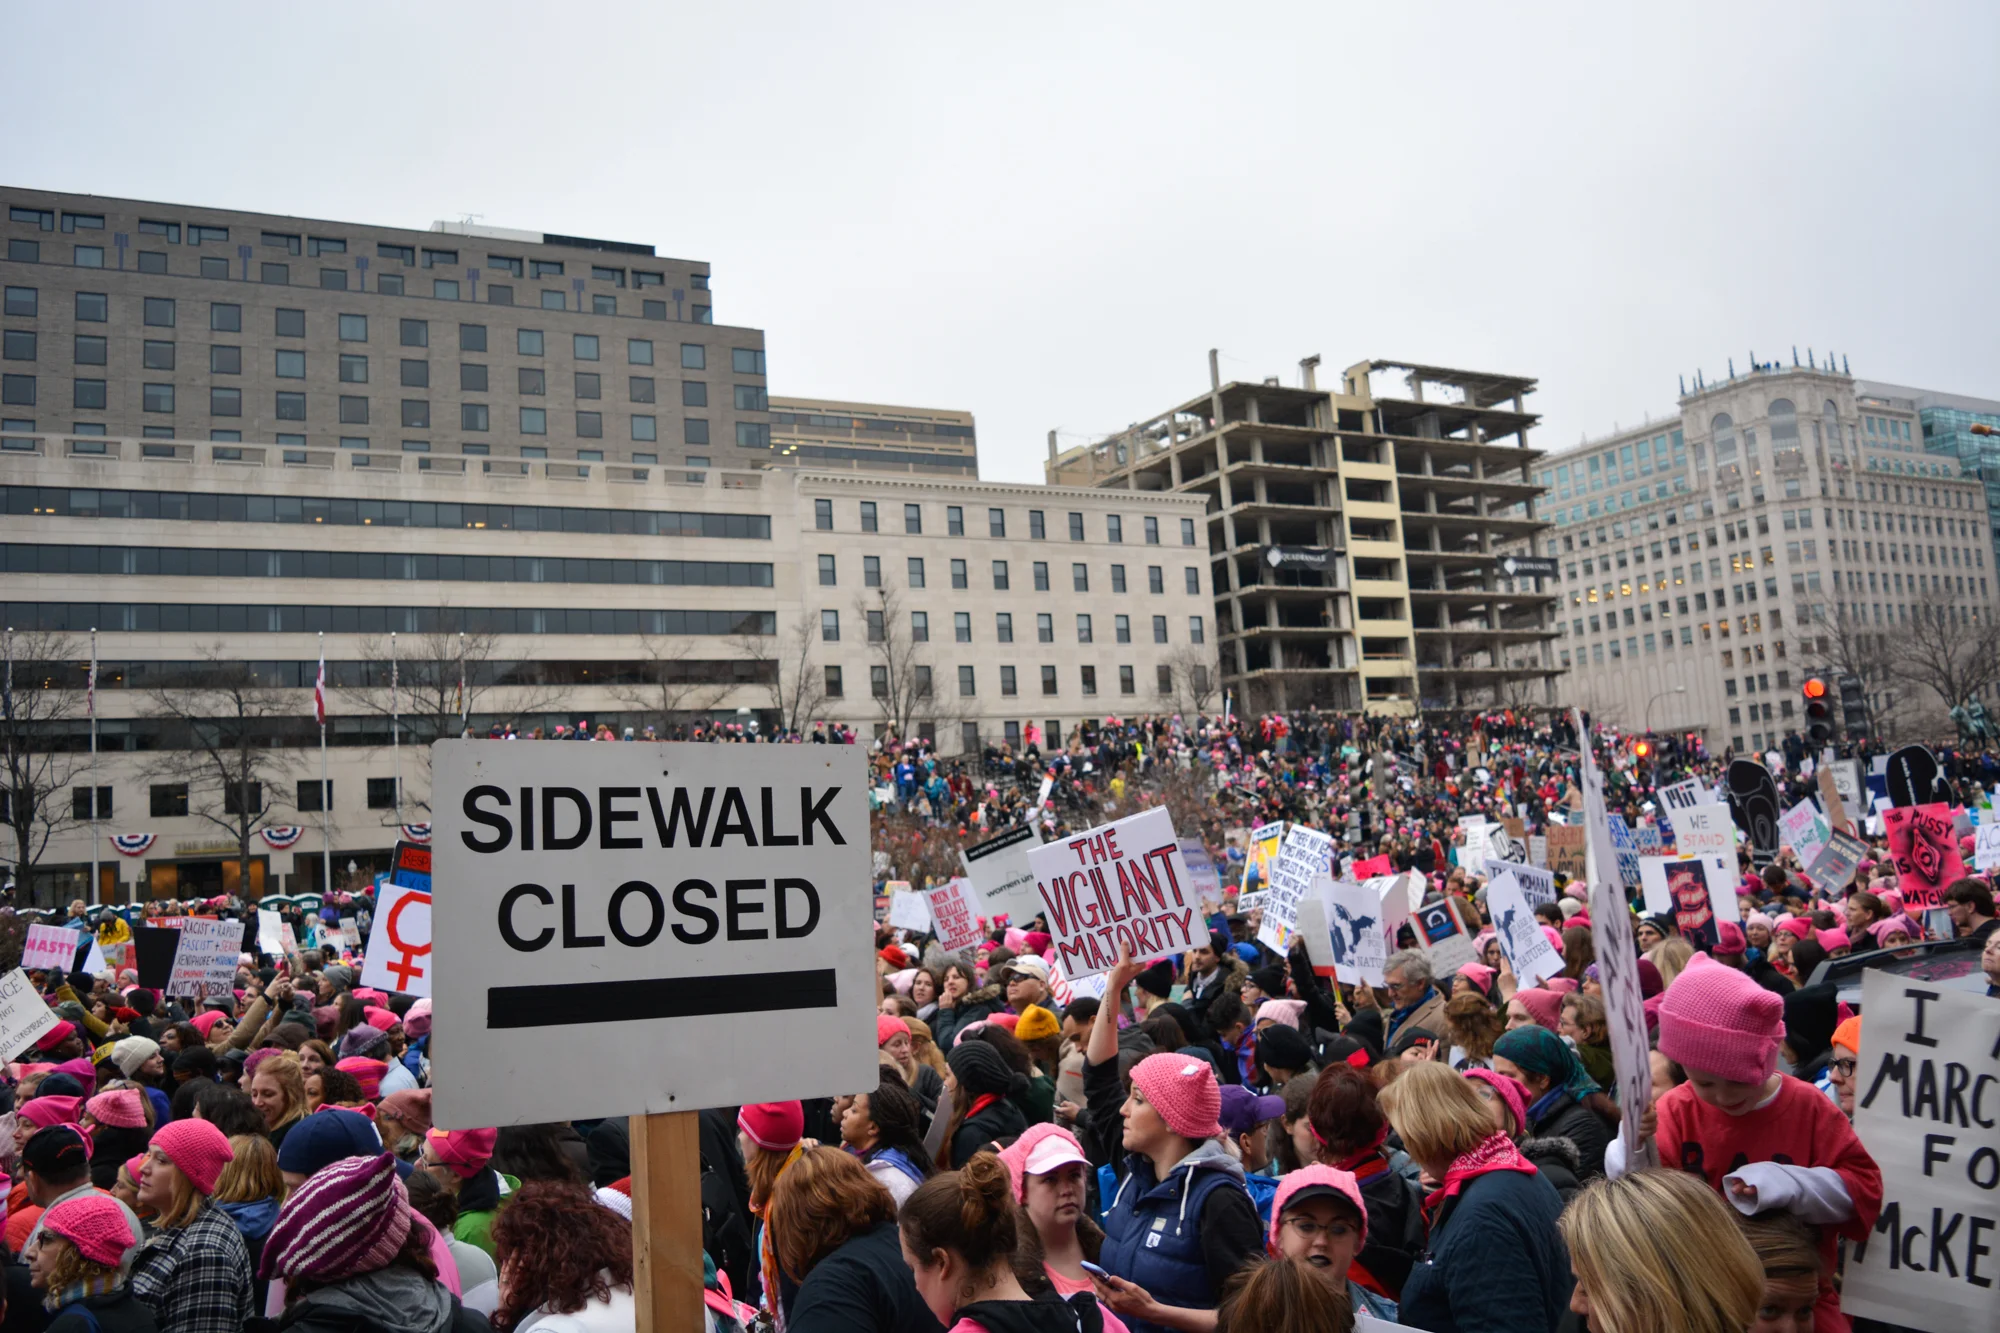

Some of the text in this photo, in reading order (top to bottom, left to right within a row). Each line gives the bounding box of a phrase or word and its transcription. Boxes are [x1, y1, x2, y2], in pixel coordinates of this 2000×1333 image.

[461, 785, 847, 853] SIDEWALK
[1690, 814, 1710, 829] WE
[1911, 809, 1954, 839] PUSSY
[1069, 828, 1123, 865] THE
[1684, 834, 1725, 848] STAND
[1558, 847, 1567, 858] A
[1896, 857, 1911, 876] IS
[929, 889, 950, 905] MEN
[986, 879, 1021, 898] women
[1038, 843, 1184, 937] VIGILANT
[498, 878, 821, 952] CLOSED
[934, 898, 967, 919] QUALITY
[183, 920, 210, 936] RACIST
[216, 924, 241, 938] RAPIST
[939, 910, 970, 930] DO NOT
[947, 923, 971, 939] FEAR
[26, 938, 76, 956] NASTY
[180, 937, 213, 951] FASCIST
[219, 940, 242, 952] SEXIST
[1058, 908, 1192, 975] MAJORITY
[170, 980, 190, 995] NOT
[1904, 988, 1941, 1048] I
[1, 1025, 10, 1035] A
[1923, 1133, 2000, 1190] FO
